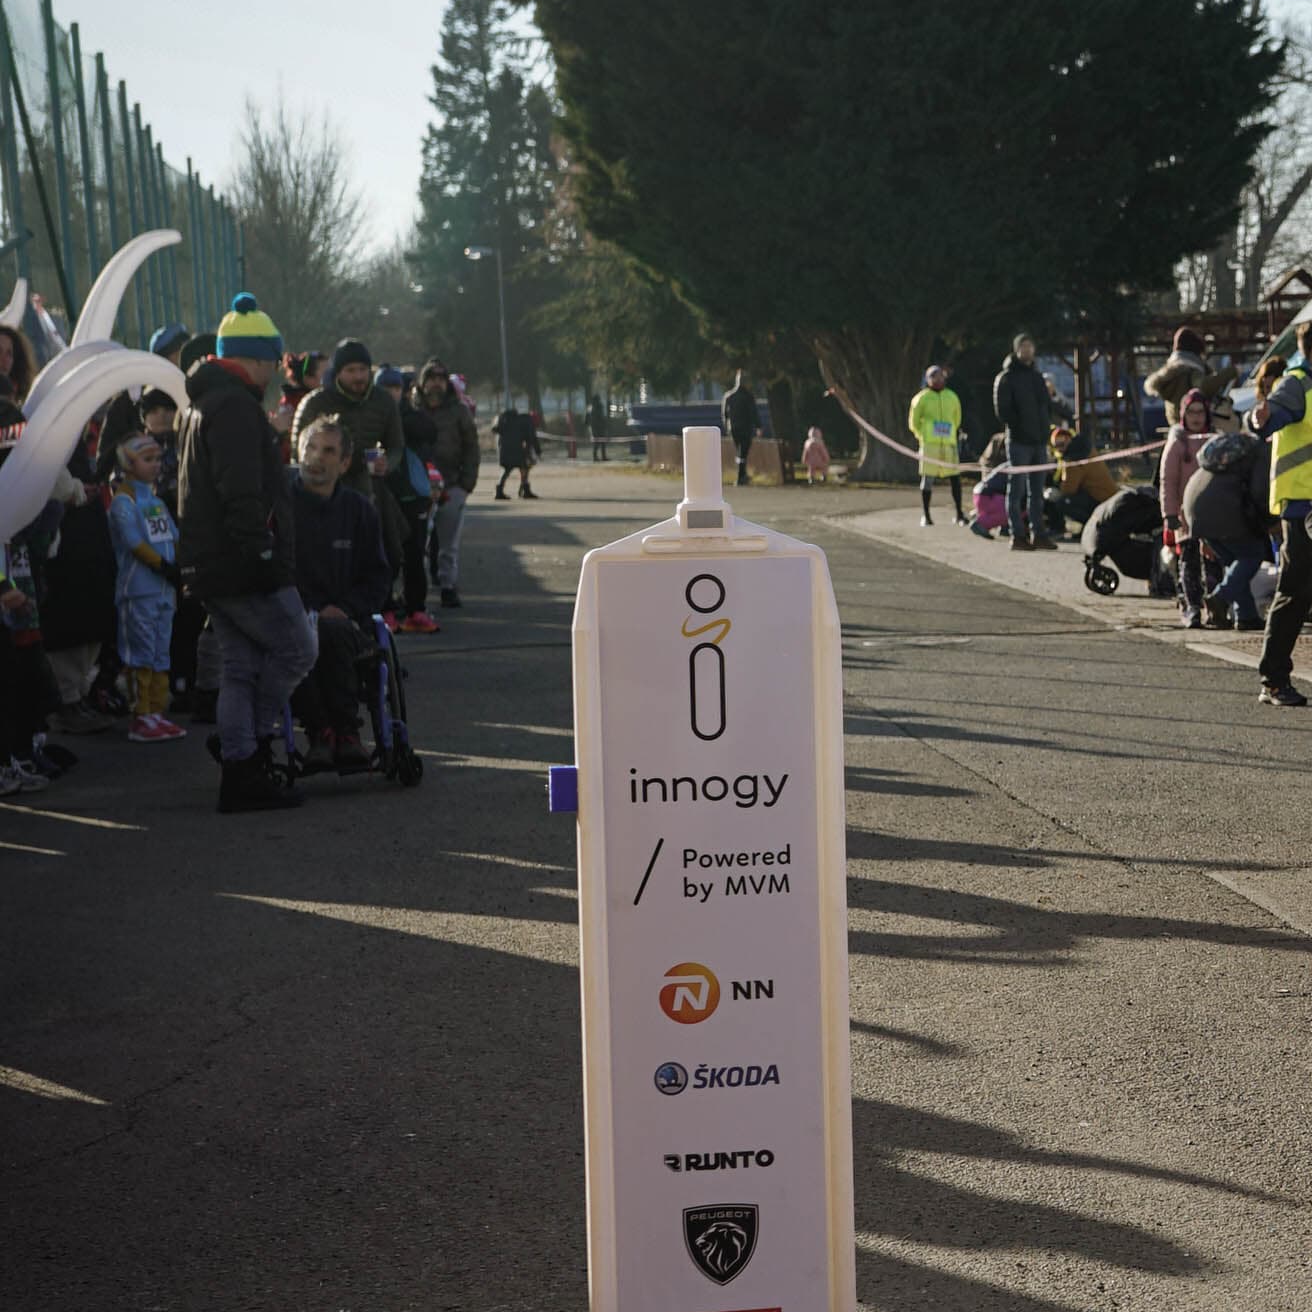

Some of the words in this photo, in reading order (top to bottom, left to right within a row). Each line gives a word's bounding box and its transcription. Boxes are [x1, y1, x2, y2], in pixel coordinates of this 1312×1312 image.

[629, 767, 789, 809] innogy
[683, 843, 791, 869] Powered
[683, 876, 714, 904] by
[725, 873, 790, 896] MVM
[731, 979, 774, 1001] NN
[692, 1063, 780, 1089] ŠKODA
[685, 1149, 775, 1172] RUNTO
[690, 1211, 752, 1221] PEUGEOT
